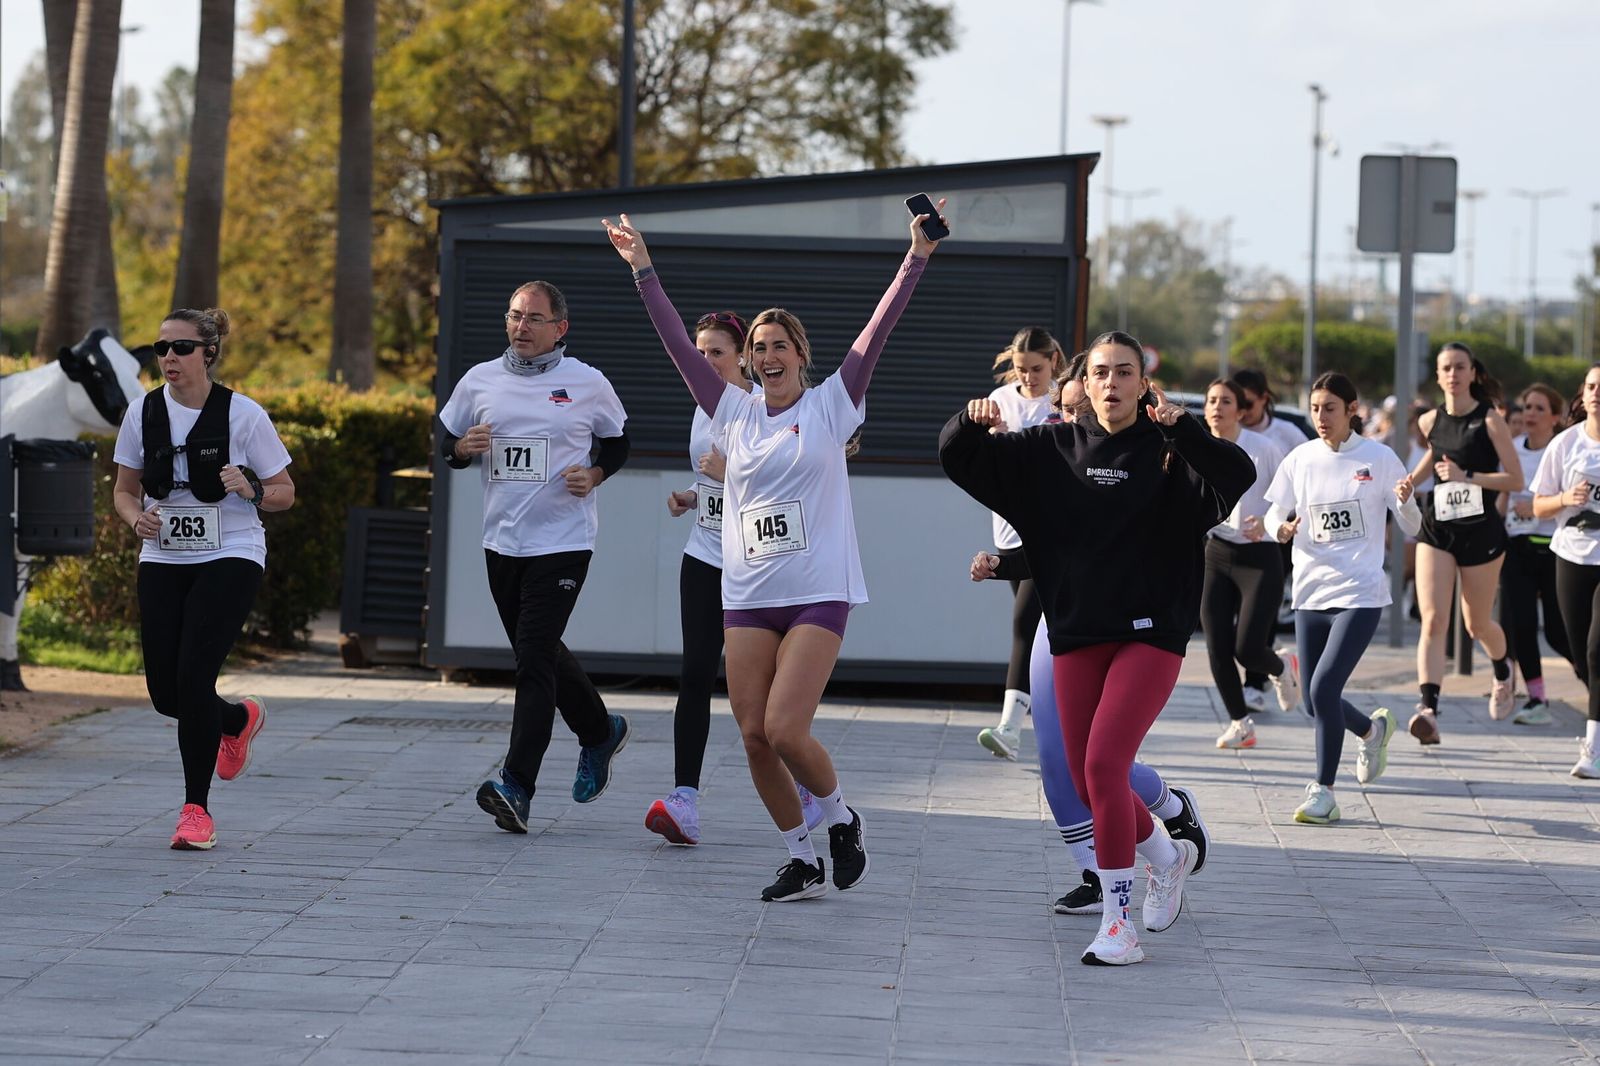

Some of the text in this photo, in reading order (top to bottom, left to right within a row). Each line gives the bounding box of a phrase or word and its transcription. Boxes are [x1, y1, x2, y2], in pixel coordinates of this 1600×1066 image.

[200, 447, 219, 456] RUN
[503, 446, 531, 468] 171
[707, 495, 724, 518] 94
[1446, 489, 1471, 506] 402
[169, 516, 206, 538] 263
[754, 513, 788, 542] 145
[1321, 510, 1352, 530] 233
[1110, 879, 1132, 894] JU
[1119, 893, 1129, 907] D
